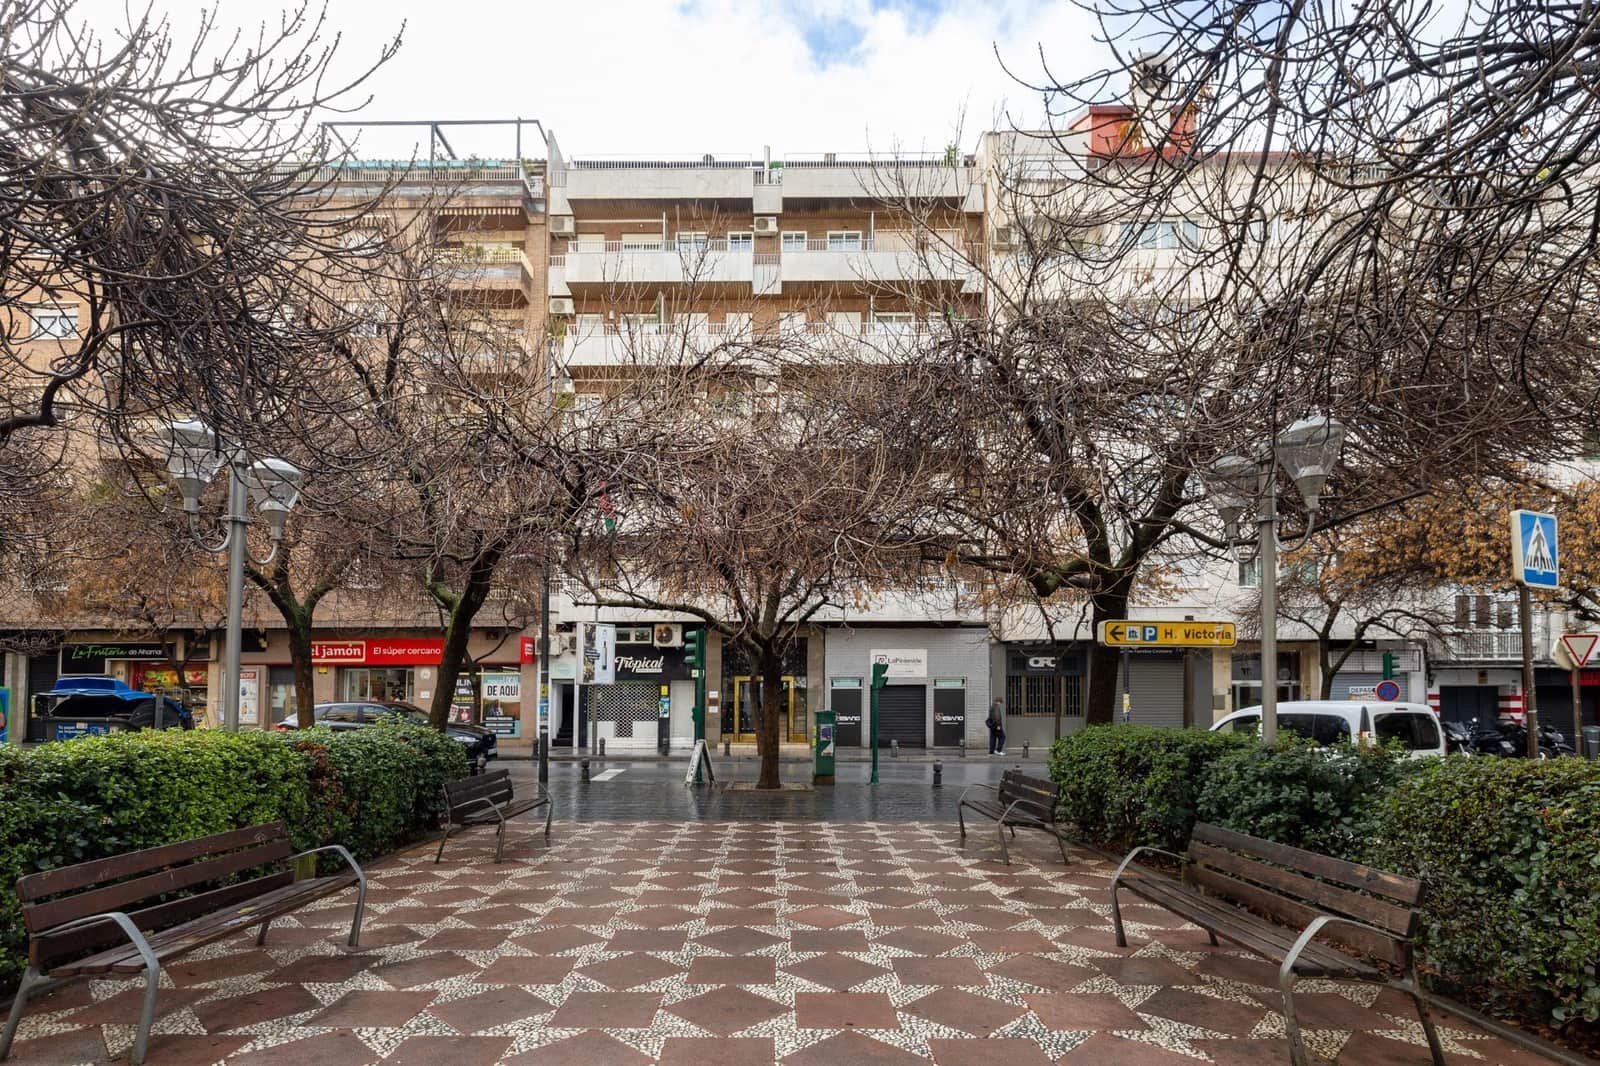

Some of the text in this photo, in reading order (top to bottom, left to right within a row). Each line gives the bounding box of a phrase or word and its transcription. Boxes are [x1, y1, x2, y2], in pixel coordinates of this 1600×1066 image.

[1164, 629, 1178, 639] H.
[1184, 628, 1232, 640] Victoria
[321, 642, 361, 659] jamón
[373, 647, 382, 655] El
[382, 646, 406, 656] súper
[614, 655, 664, 673] Tropical
[487, 685, 498, 696] DE
